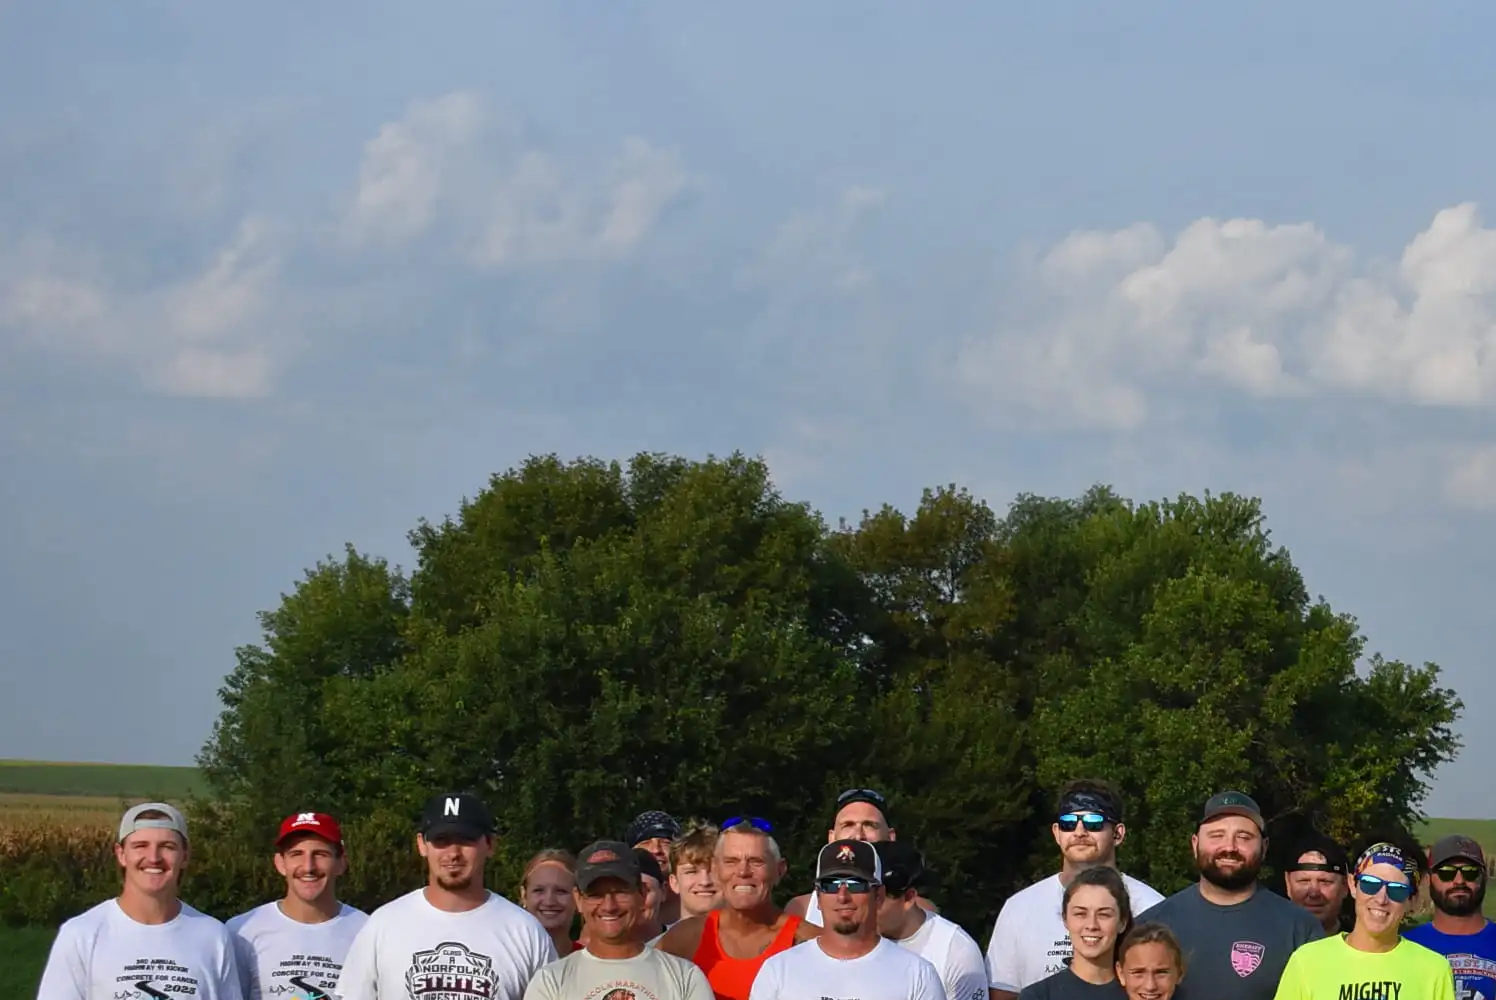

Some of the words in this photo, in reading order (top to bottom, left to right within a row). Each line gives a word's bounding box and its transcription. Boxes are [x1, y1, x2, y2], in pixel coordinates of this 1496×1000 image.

[444, 798, 460, 816] N
[423, 964, 481, 975] NORFOLK
[163, 984, 197, 995] 2025
[412, 974, 486, 994] STATE
